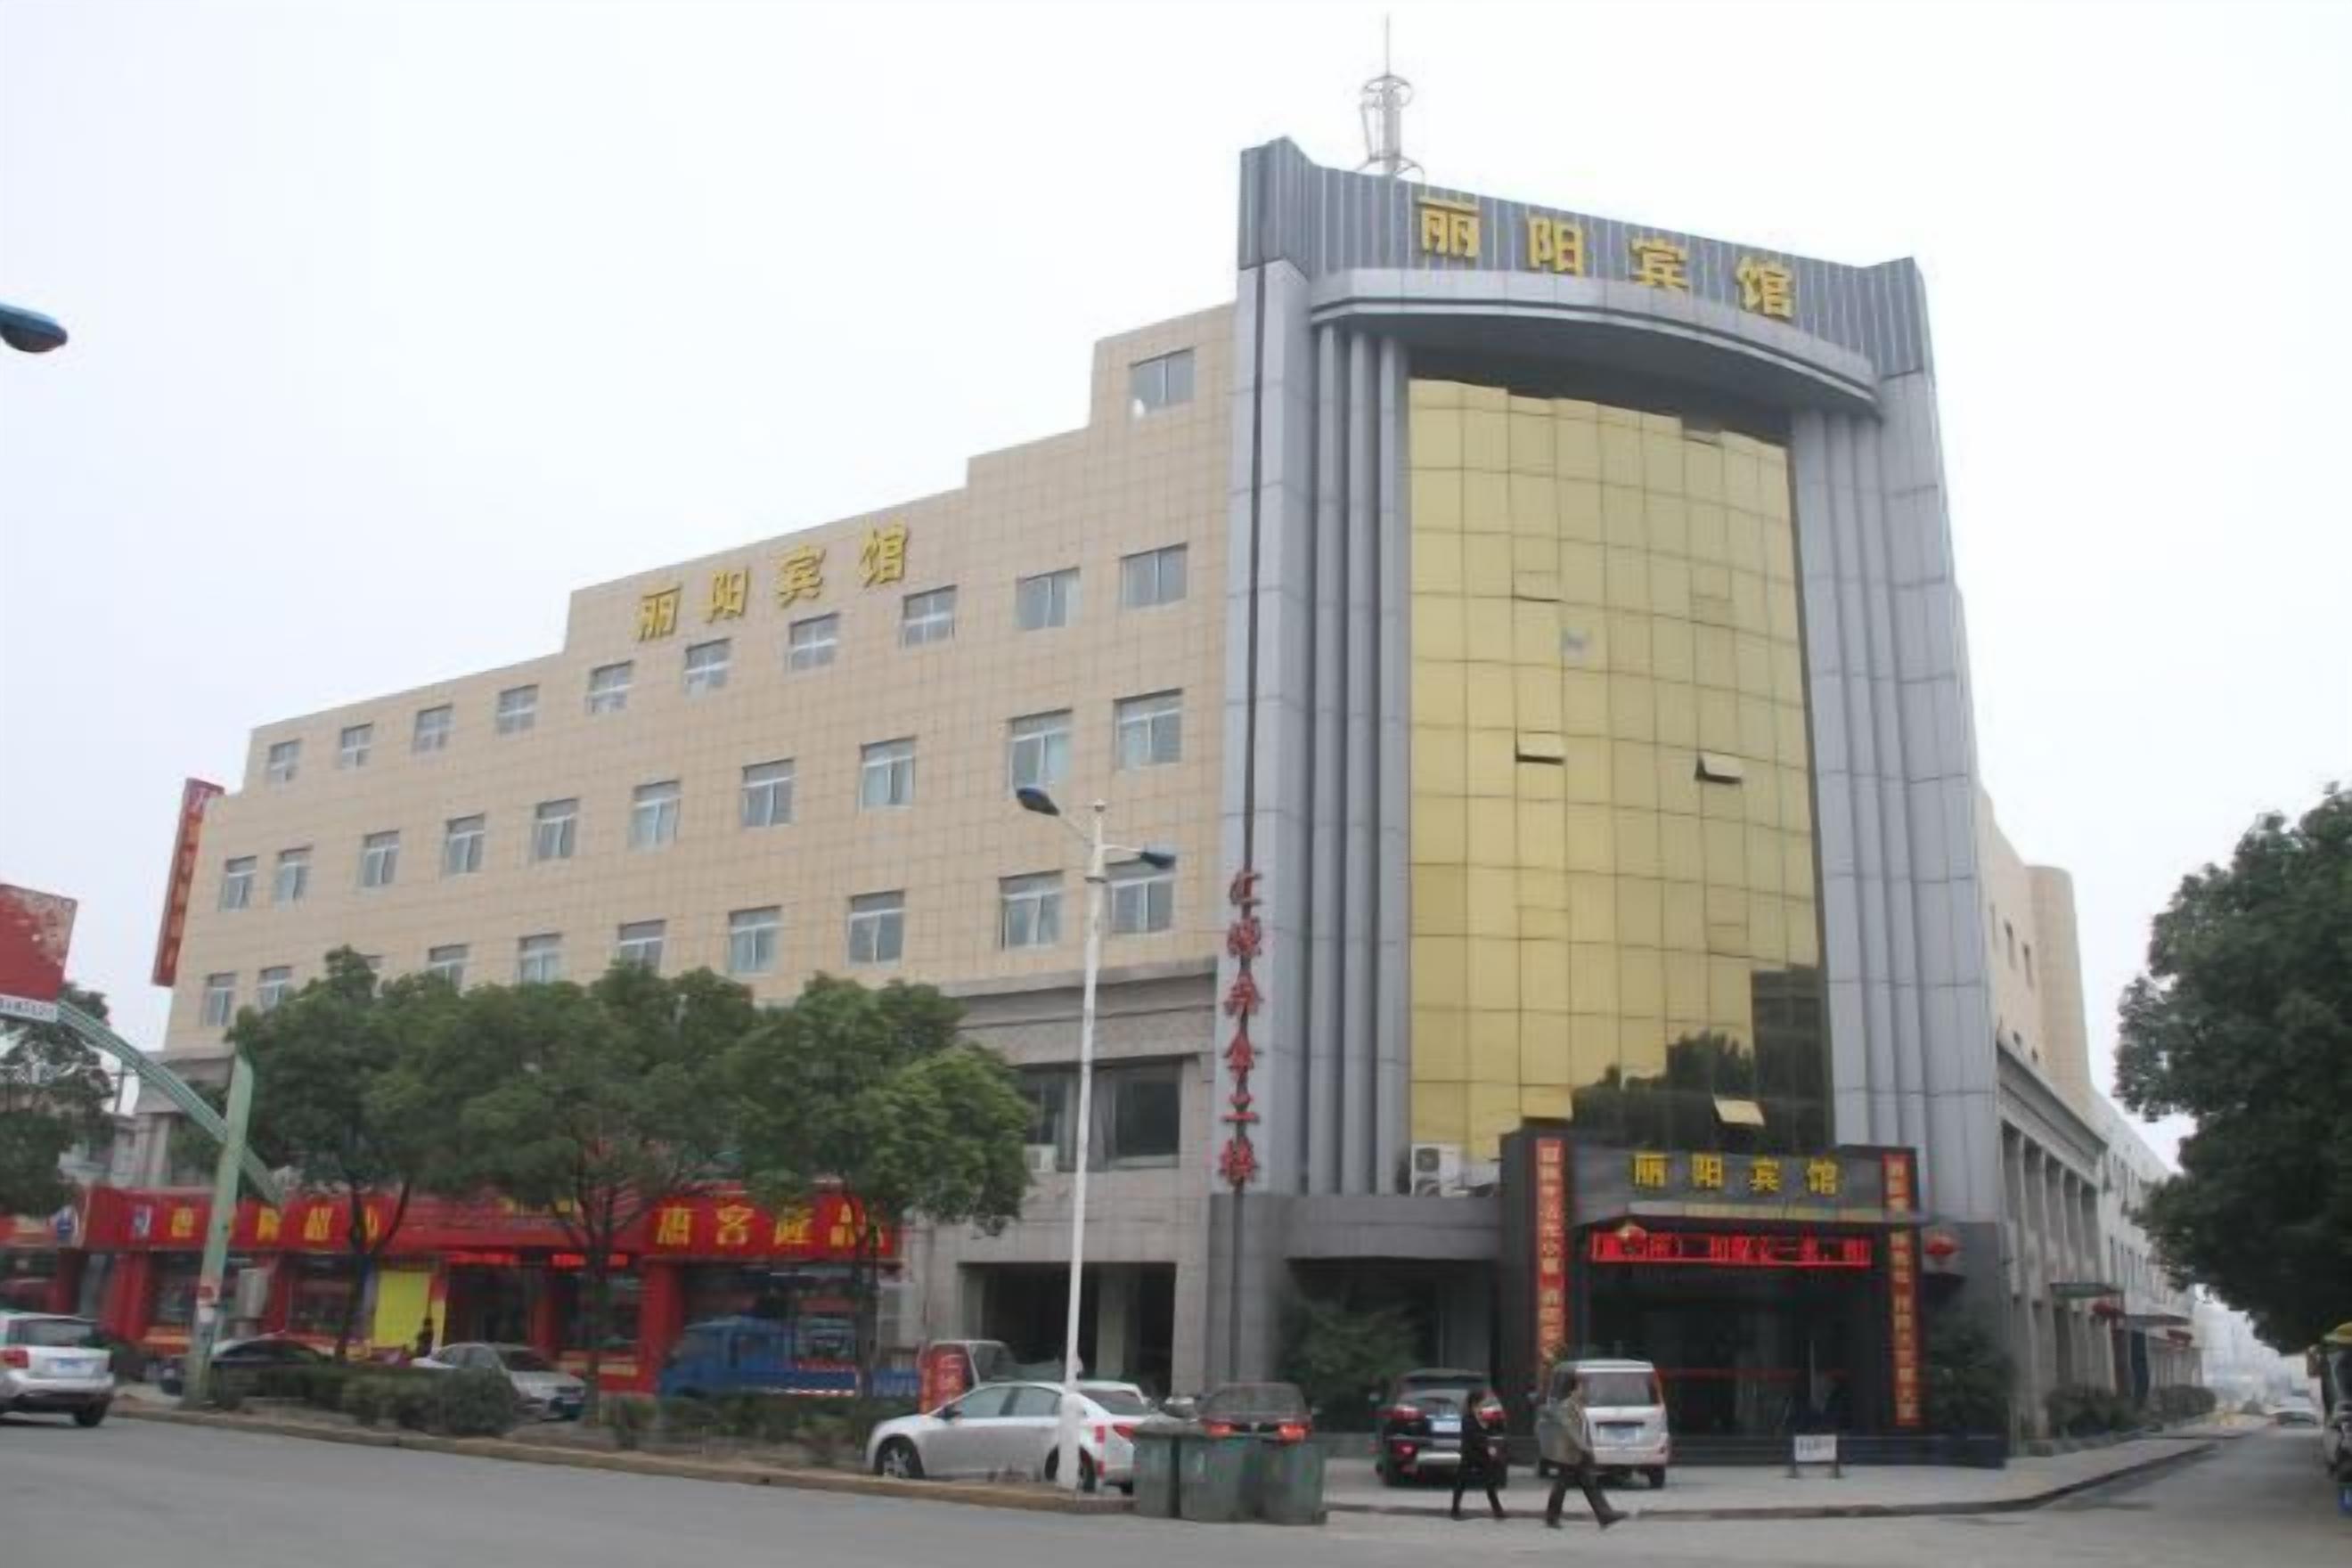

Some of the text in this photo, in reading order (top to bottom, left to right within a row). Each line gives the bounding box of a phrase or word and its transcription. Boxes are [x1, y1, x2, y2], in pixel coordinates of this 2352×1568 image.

[1418, 195, 1794, 320] 丽阳宾馆
[631, 516, 909, 642] 丽阳宾馆
[1634, 1153, 1838, 1196] 丽阳宾馆
